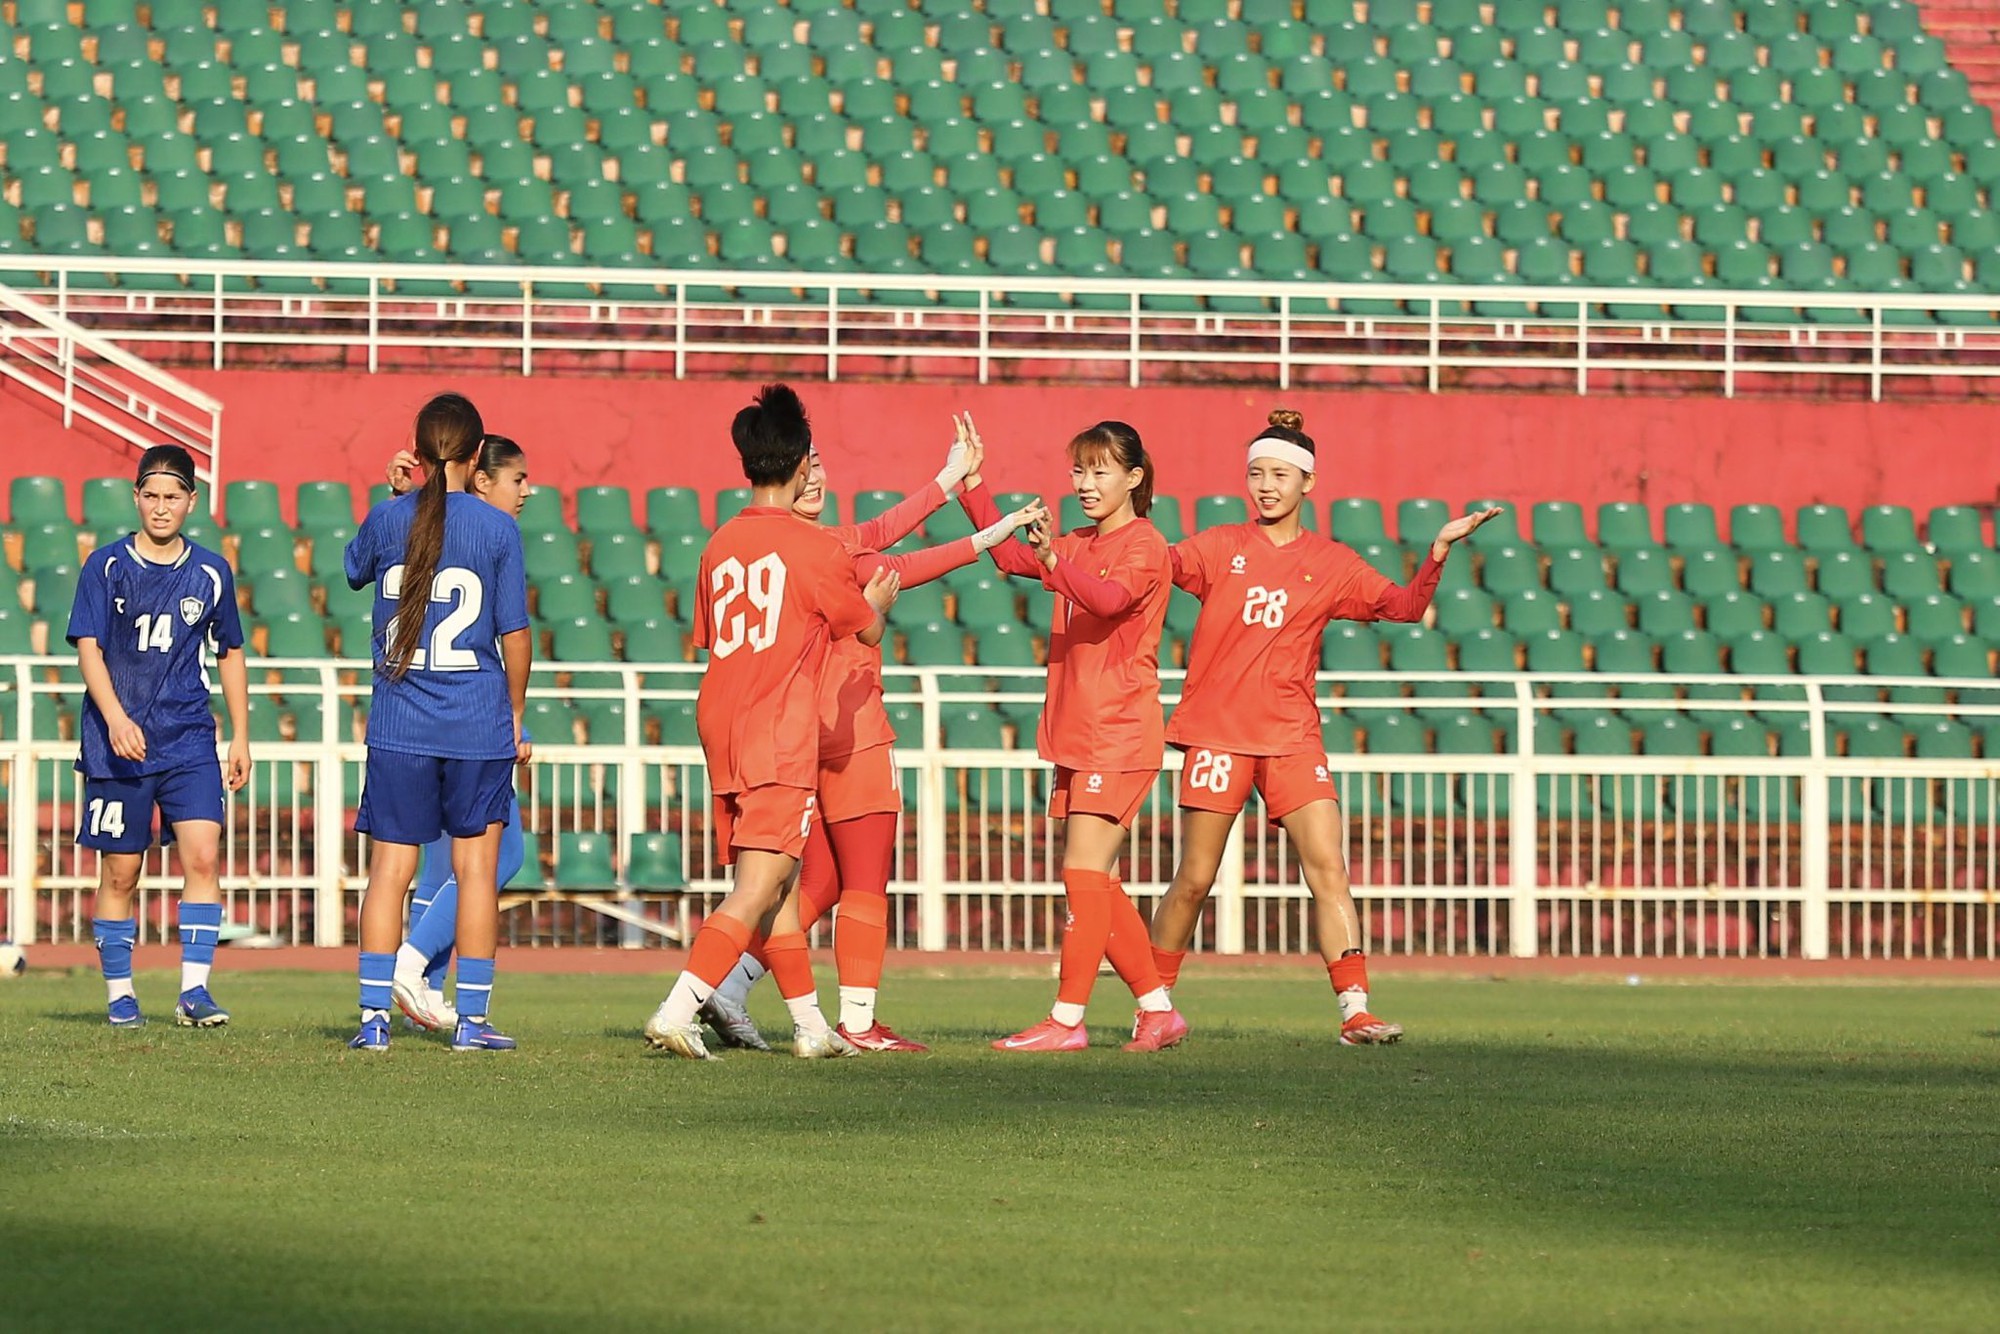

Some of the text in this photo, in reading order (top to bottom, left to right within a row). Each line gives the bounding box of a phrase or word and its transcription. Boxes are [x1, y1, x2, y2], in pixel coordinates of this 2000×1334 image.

[711, 551, 787, 659] 29
[1242, 585, 1288, 629] 28
[134, 614, 173, 653] 14
[1190, 749, 1233, 793] 28
[89, 798, 125, 838] 14
